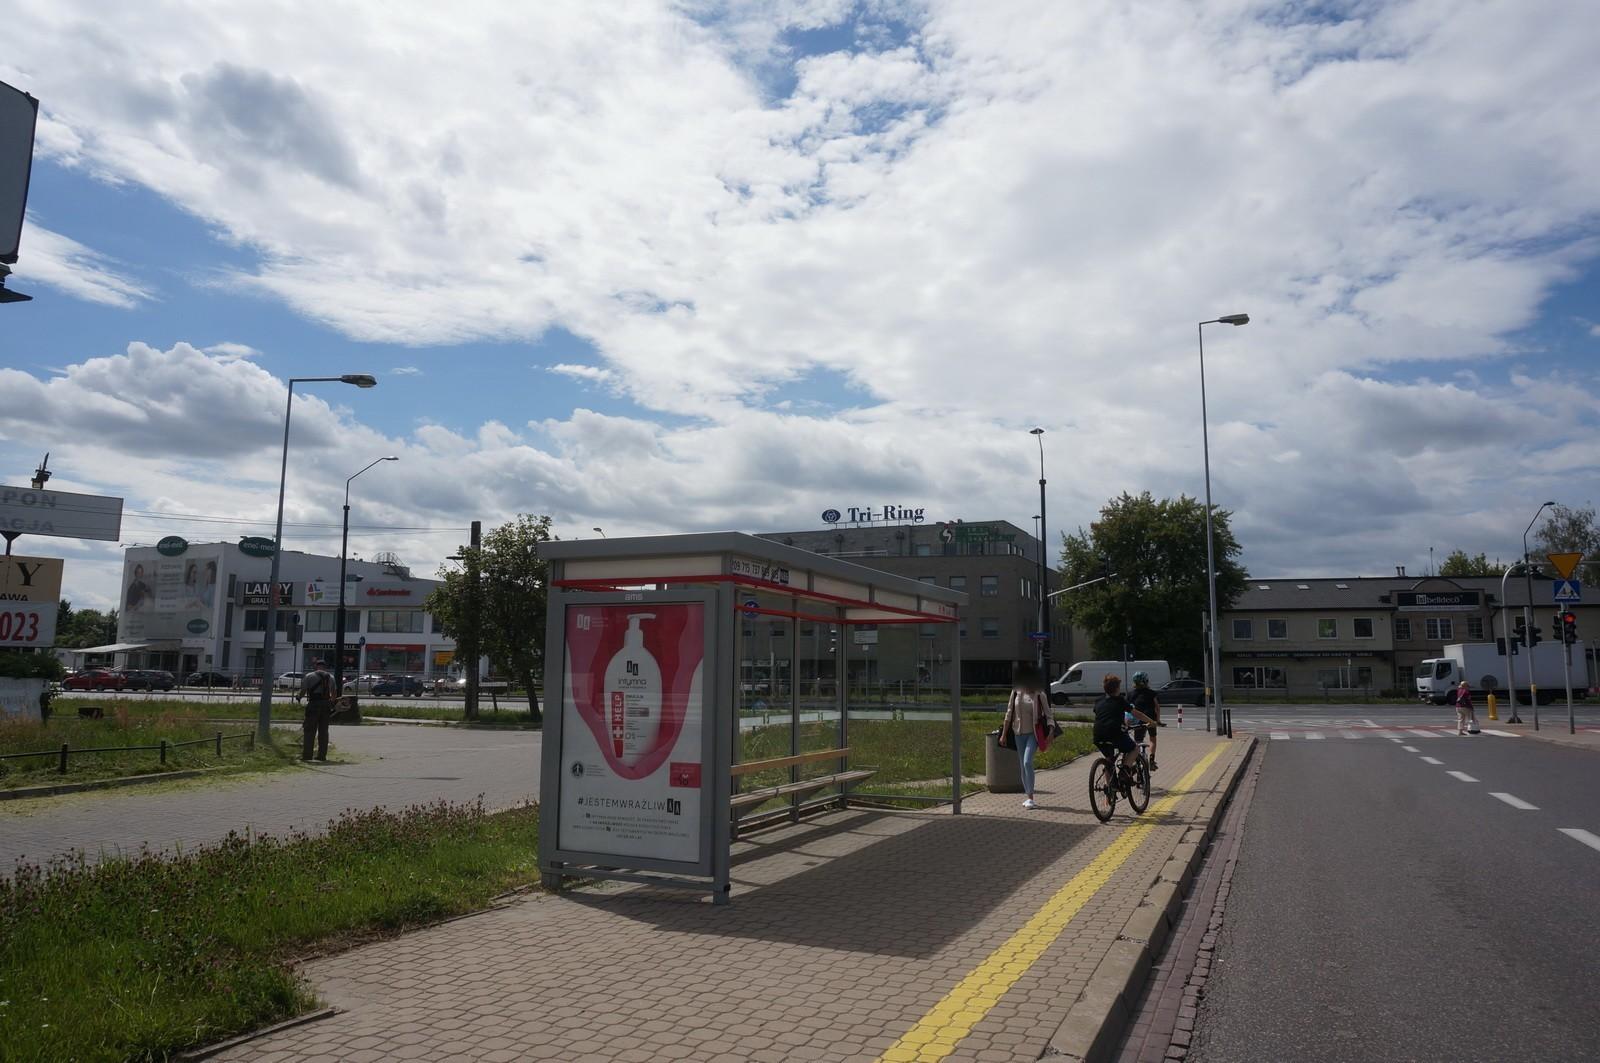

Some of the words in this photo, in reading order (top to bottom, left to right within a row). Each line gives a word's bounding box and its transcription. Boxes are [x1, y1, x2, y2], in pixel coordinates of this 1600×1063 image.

[847, 505, 925, 523] Tri-Ring
[245, 583, 292, 595] LAMY
[614, 694, 623, 722] HELP
